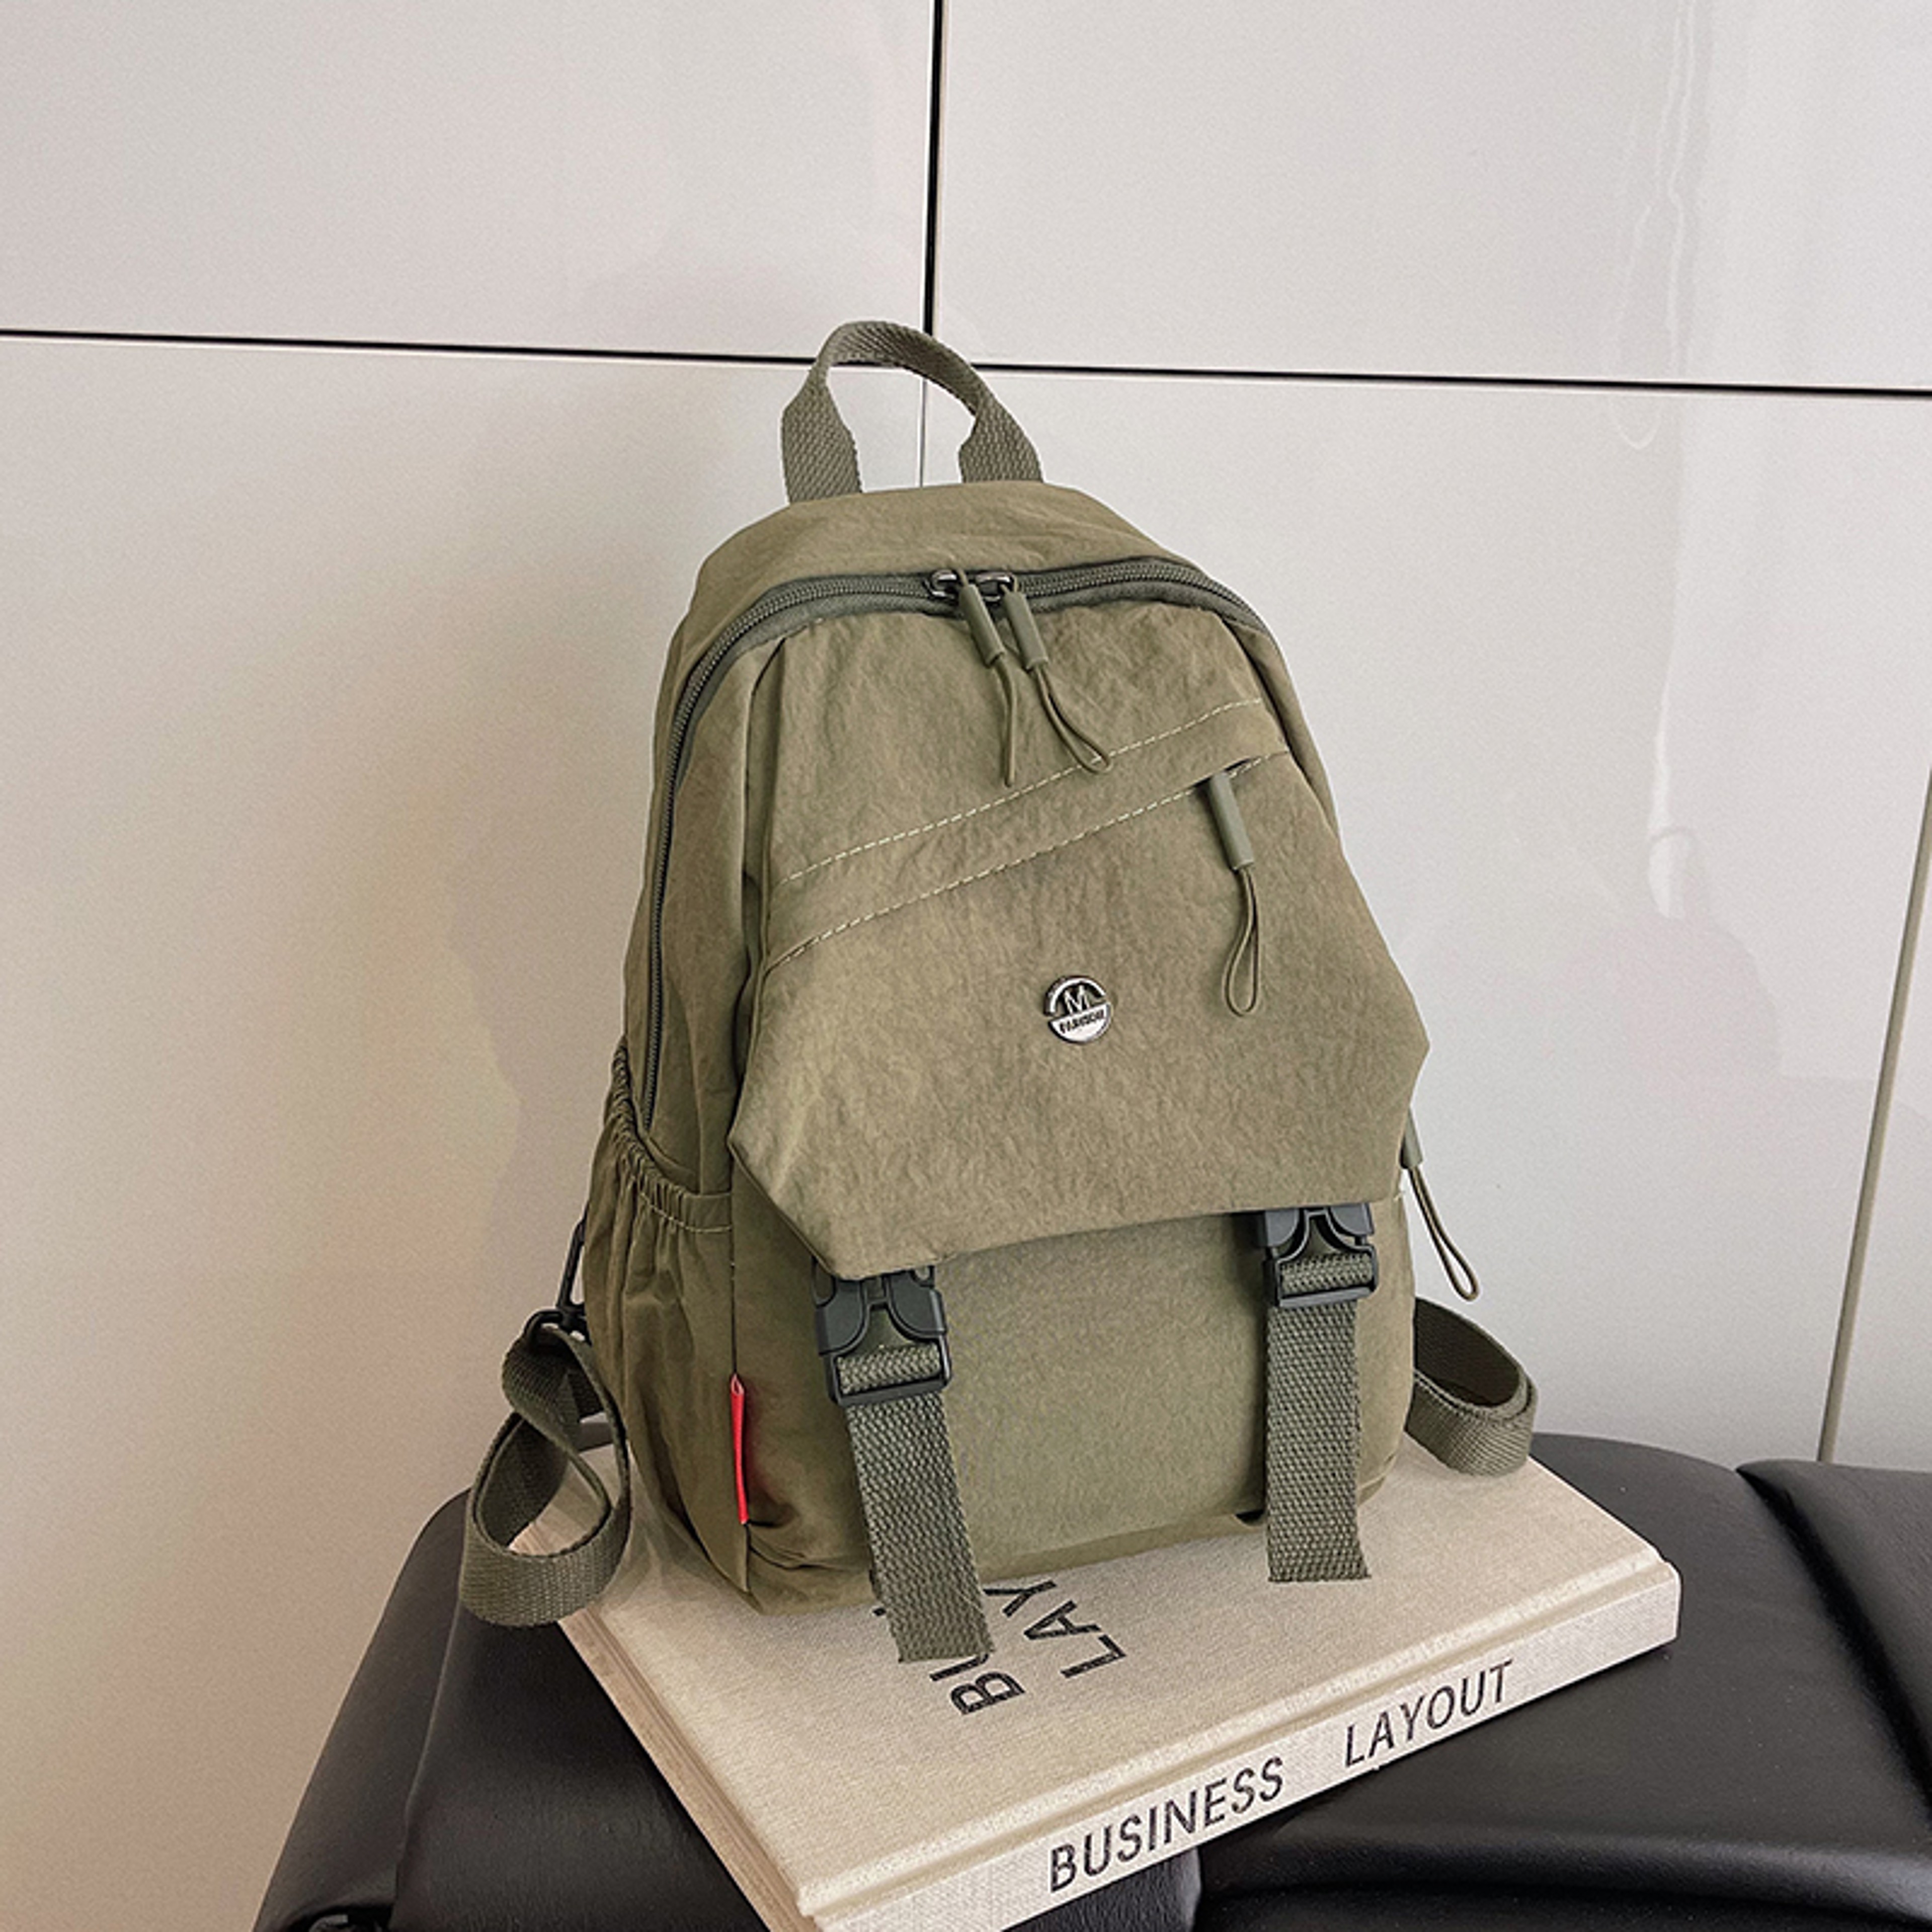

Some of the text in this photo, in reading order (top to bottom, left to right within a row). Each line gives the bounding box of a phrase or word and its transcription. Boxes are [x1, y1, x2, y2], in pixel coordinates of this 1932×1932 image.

[1064, 984, 1091, 1015] M
[1050, 1659, 1512, 1893] BUSINESS LAYOUT
